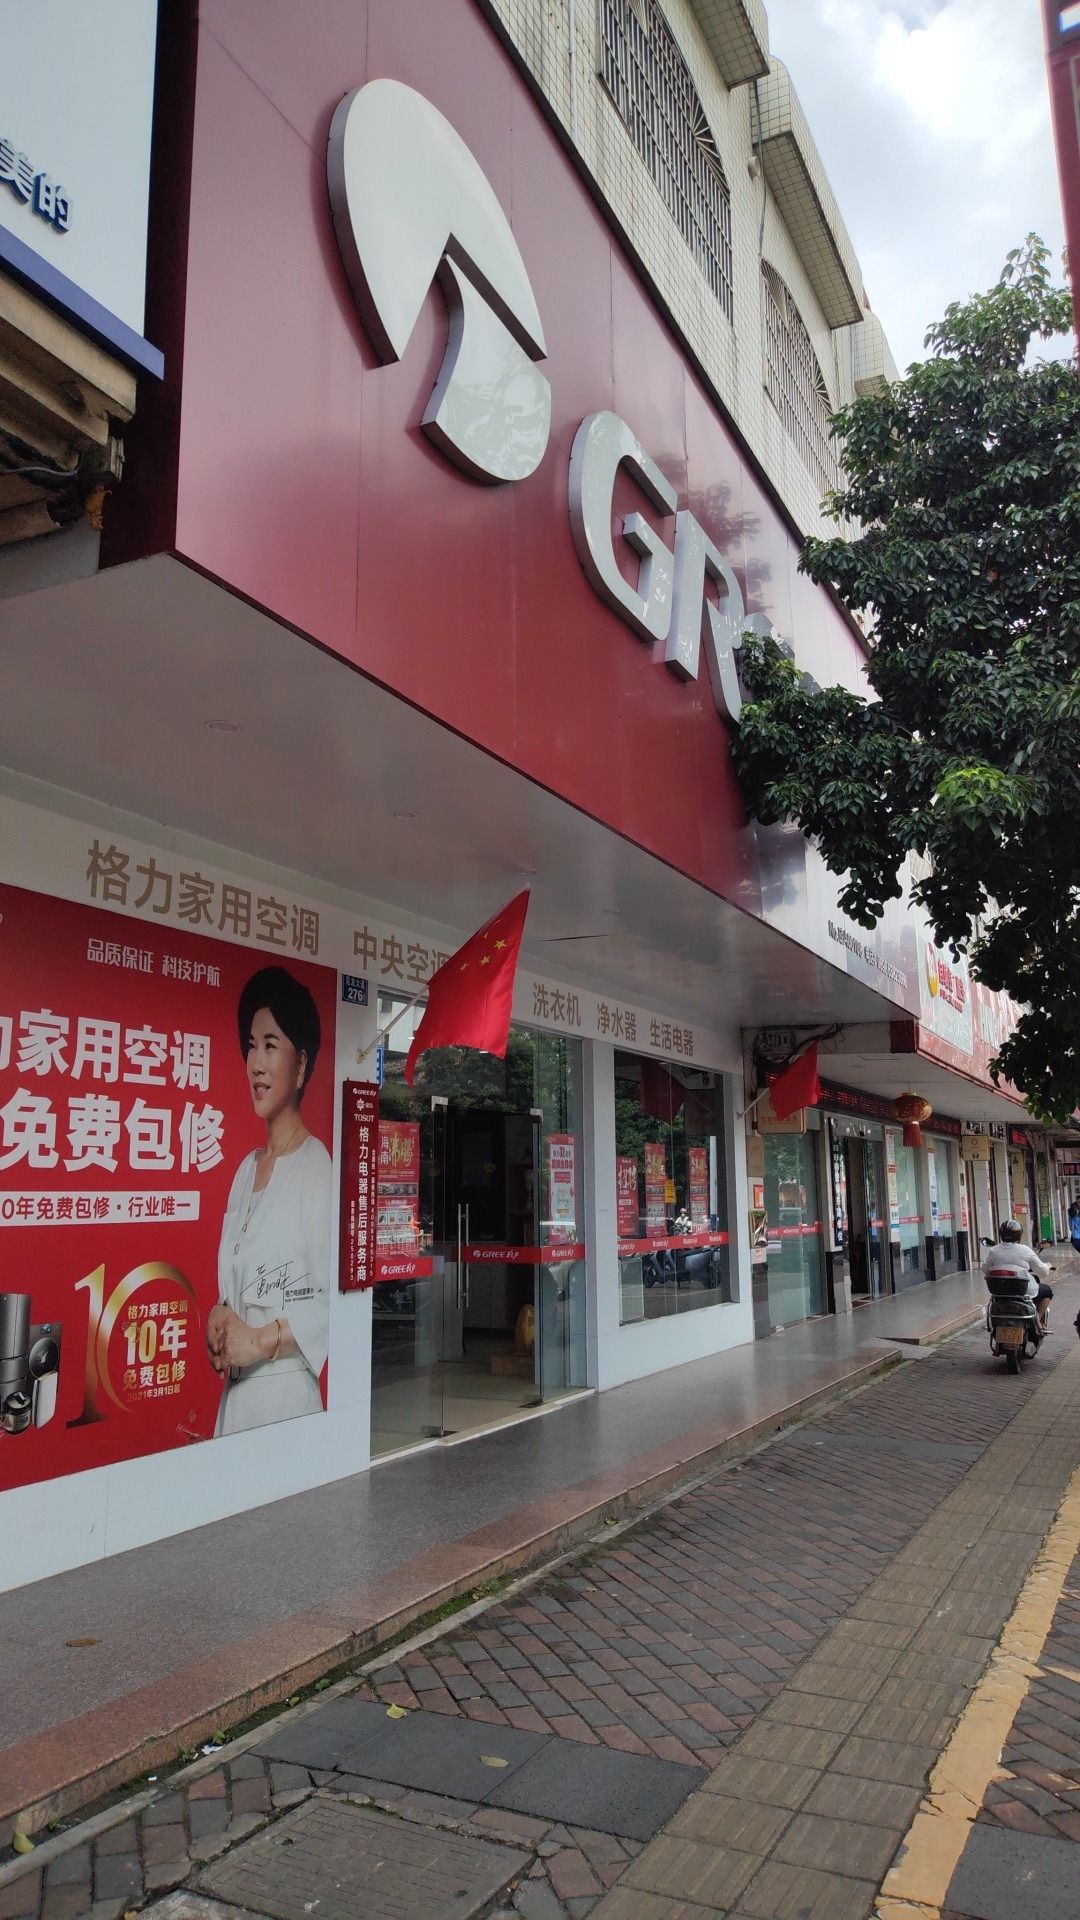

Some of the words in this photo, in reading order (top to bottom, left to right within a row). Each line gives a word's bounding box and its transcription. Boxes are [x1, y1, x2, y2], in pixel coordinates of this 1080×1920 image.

[86, 839, 320, 957] 格力家用空调
[532, 982, 582, 1027] 洗衣机
[596, 1002, 637, 1042] 净水器
[649, 1018, 694, 1057] 生活电器
[87, 937, 155, 973] 品质保证
[161, 955, 221, 988] 科技护航
[347, 987, 363, 1002] 276
[0, 1087, 225, 1174] 免费包修
[353, 1113, 375, 1123] TOSOT
[357, 1126, 370, 1282] 格力电器售后服务商
[128, 1300, 188, 1320] 格力家用空调
[124, 1318, 188, 1366] 10年
[122, 1360, 186, 1391] 免费包修
[128, 1384, 181, 1402] 2021年3月1日起
